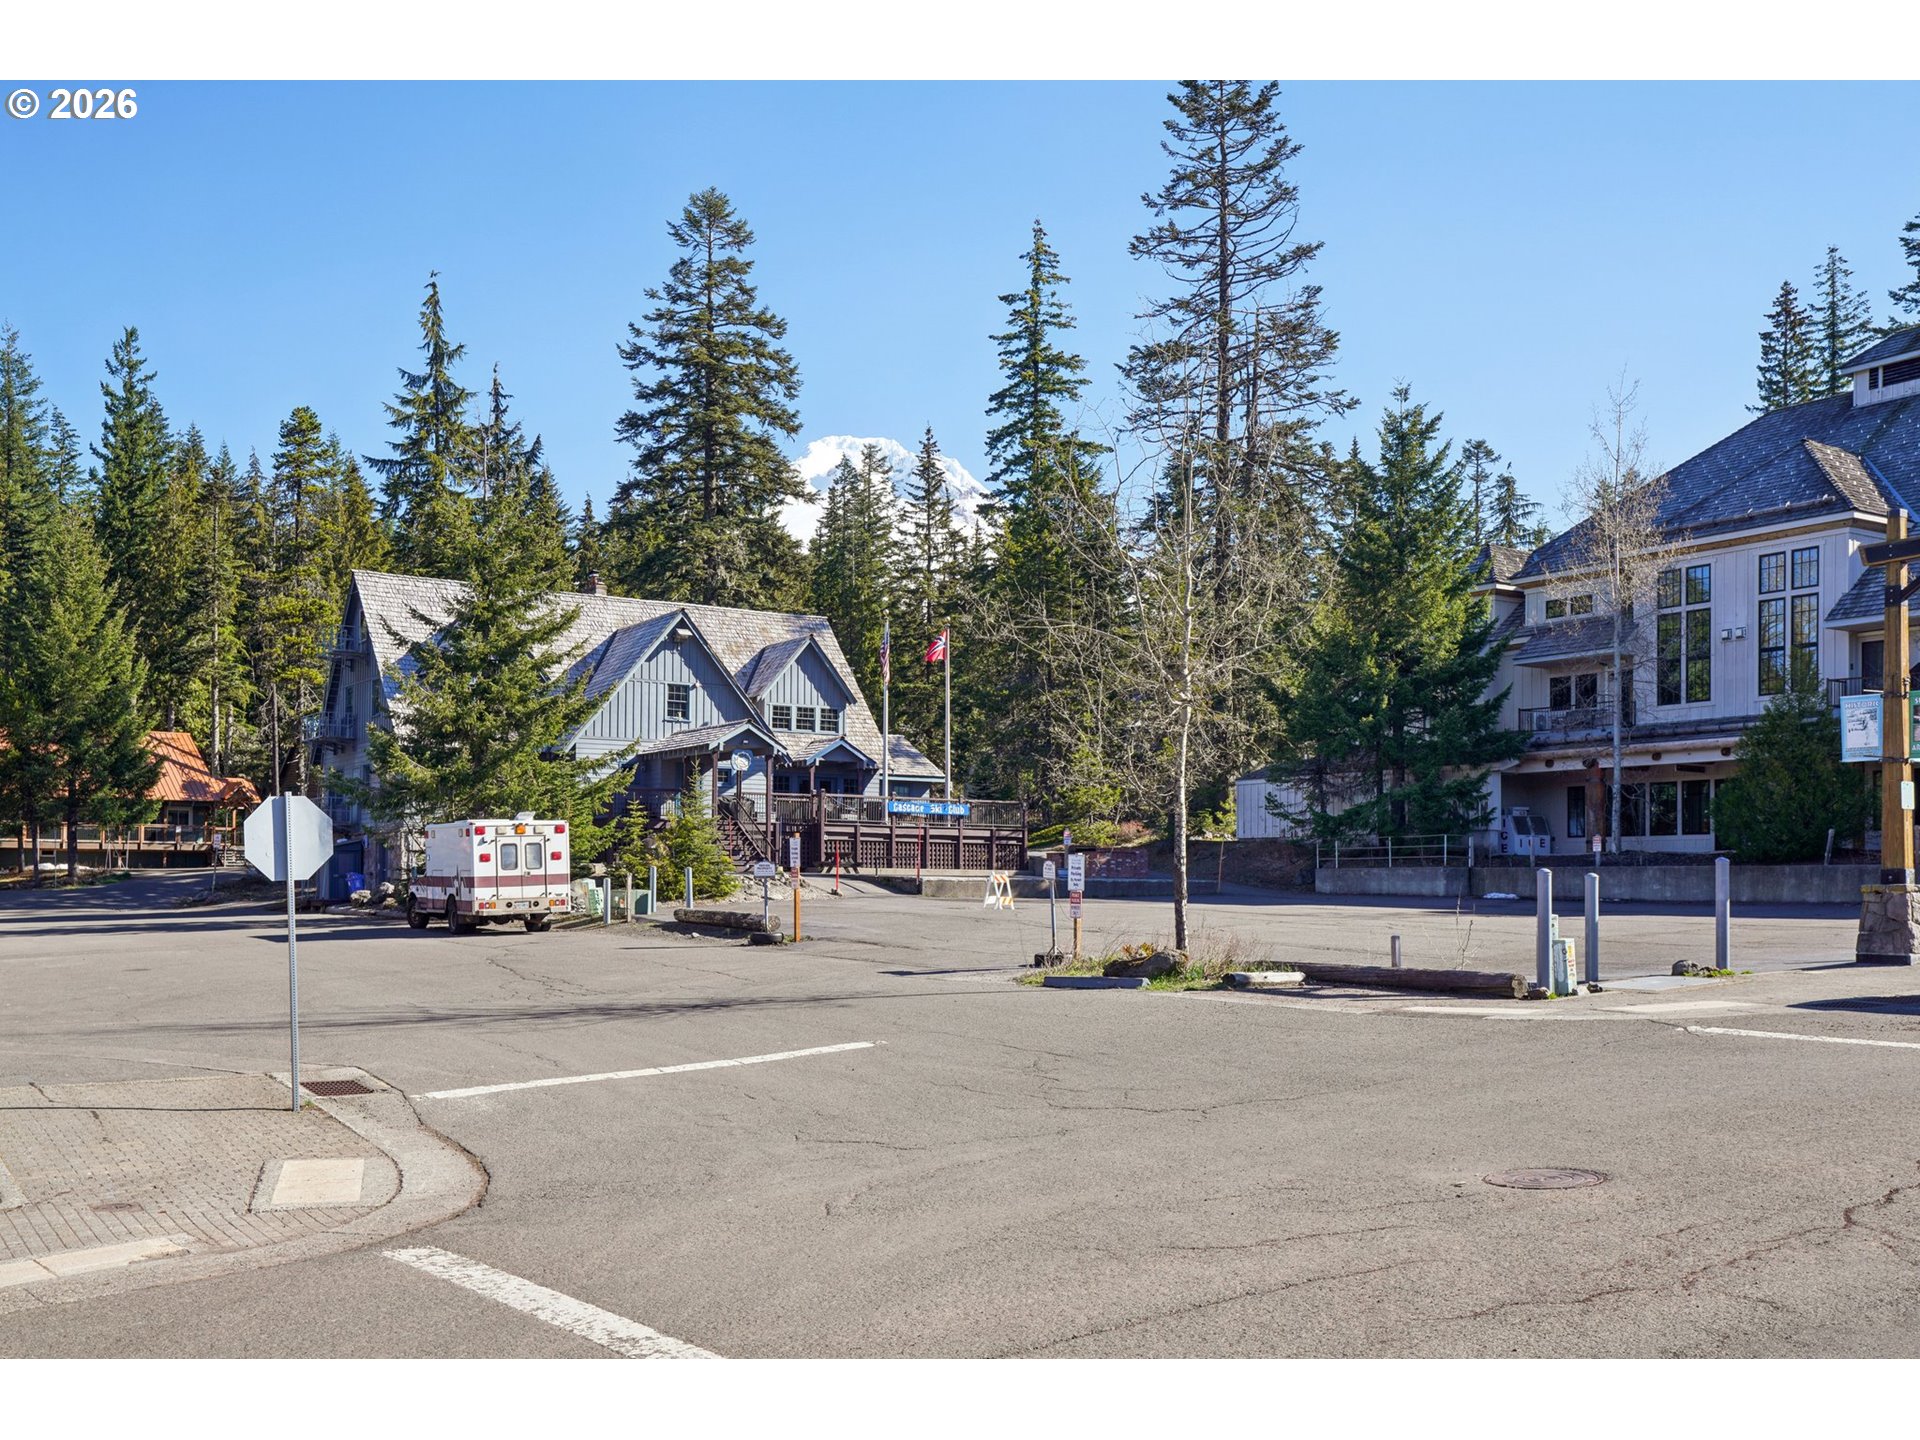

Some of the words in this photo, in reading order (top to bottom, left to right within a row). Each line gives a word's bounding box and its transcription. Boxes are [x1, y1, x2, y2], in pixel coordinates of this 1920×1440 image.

[1845, 701, 1879, 709] HISTORIC
[893, 802, 924, 812] Cascade
[930, 803, 943, 814] Ski
[948, 803, 965, 815] Club
